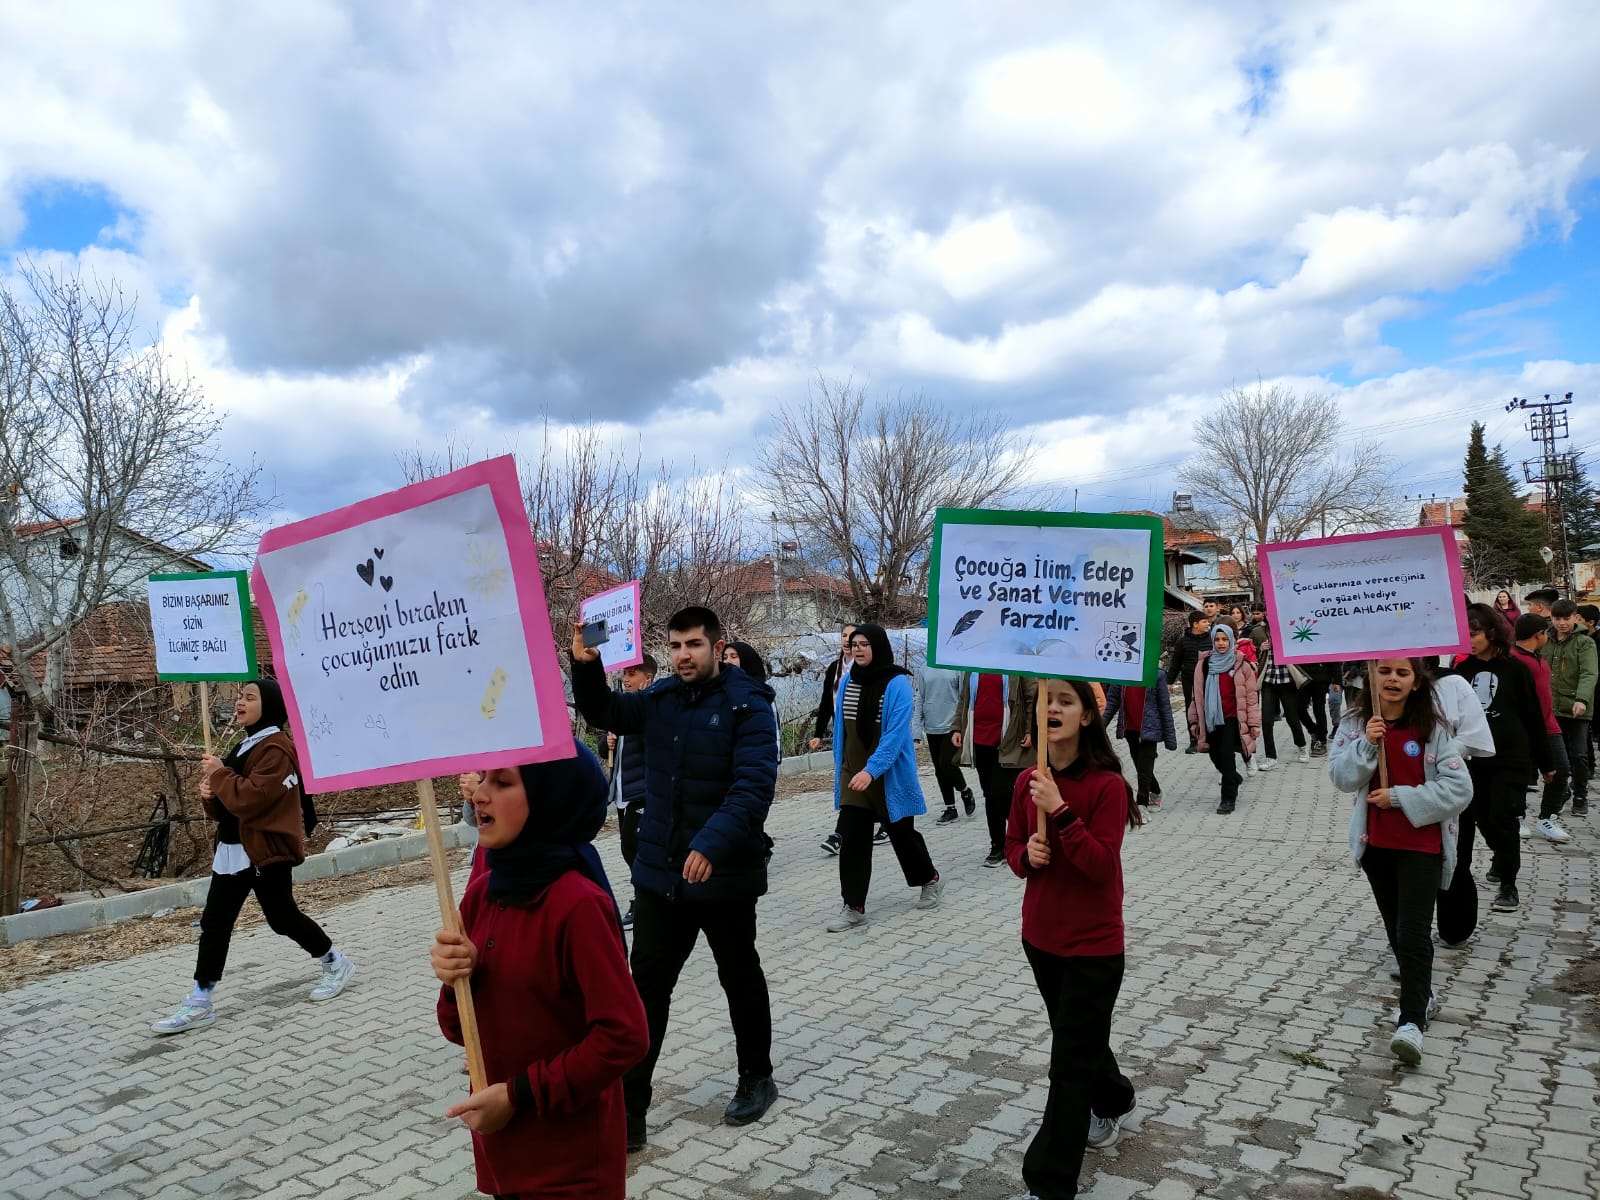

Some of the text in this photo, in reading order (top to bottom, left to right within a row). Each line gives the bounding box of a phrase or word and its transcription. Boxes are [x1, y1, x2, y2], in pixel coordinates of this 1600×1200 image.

[955, 554, 1134, 590] Çocuğa İlim, Edep
[1292, 573, 1426, 595] Çocuklarınıza vereceğiniz
[162, 593, 229, 611] BİZİM BAŞARIMIZ
[959, 582, 1127, 608] ve Sanat Vermek
[1335, 592, 1361, 604] güzel
[1364, 590, 1397, 600] hediye
[183, 615, 203, 630] SİZİN
[321, 590, 468, 641] Herşeyi bırakın
[1000, 607, 1079, 632] Farzdır.
[168, 637, 227, 652] İLGİNİZE BAĞLI
[321, 617, 480, 678] çocuğunuzu fark
[379, 663, 421, 692] edin
